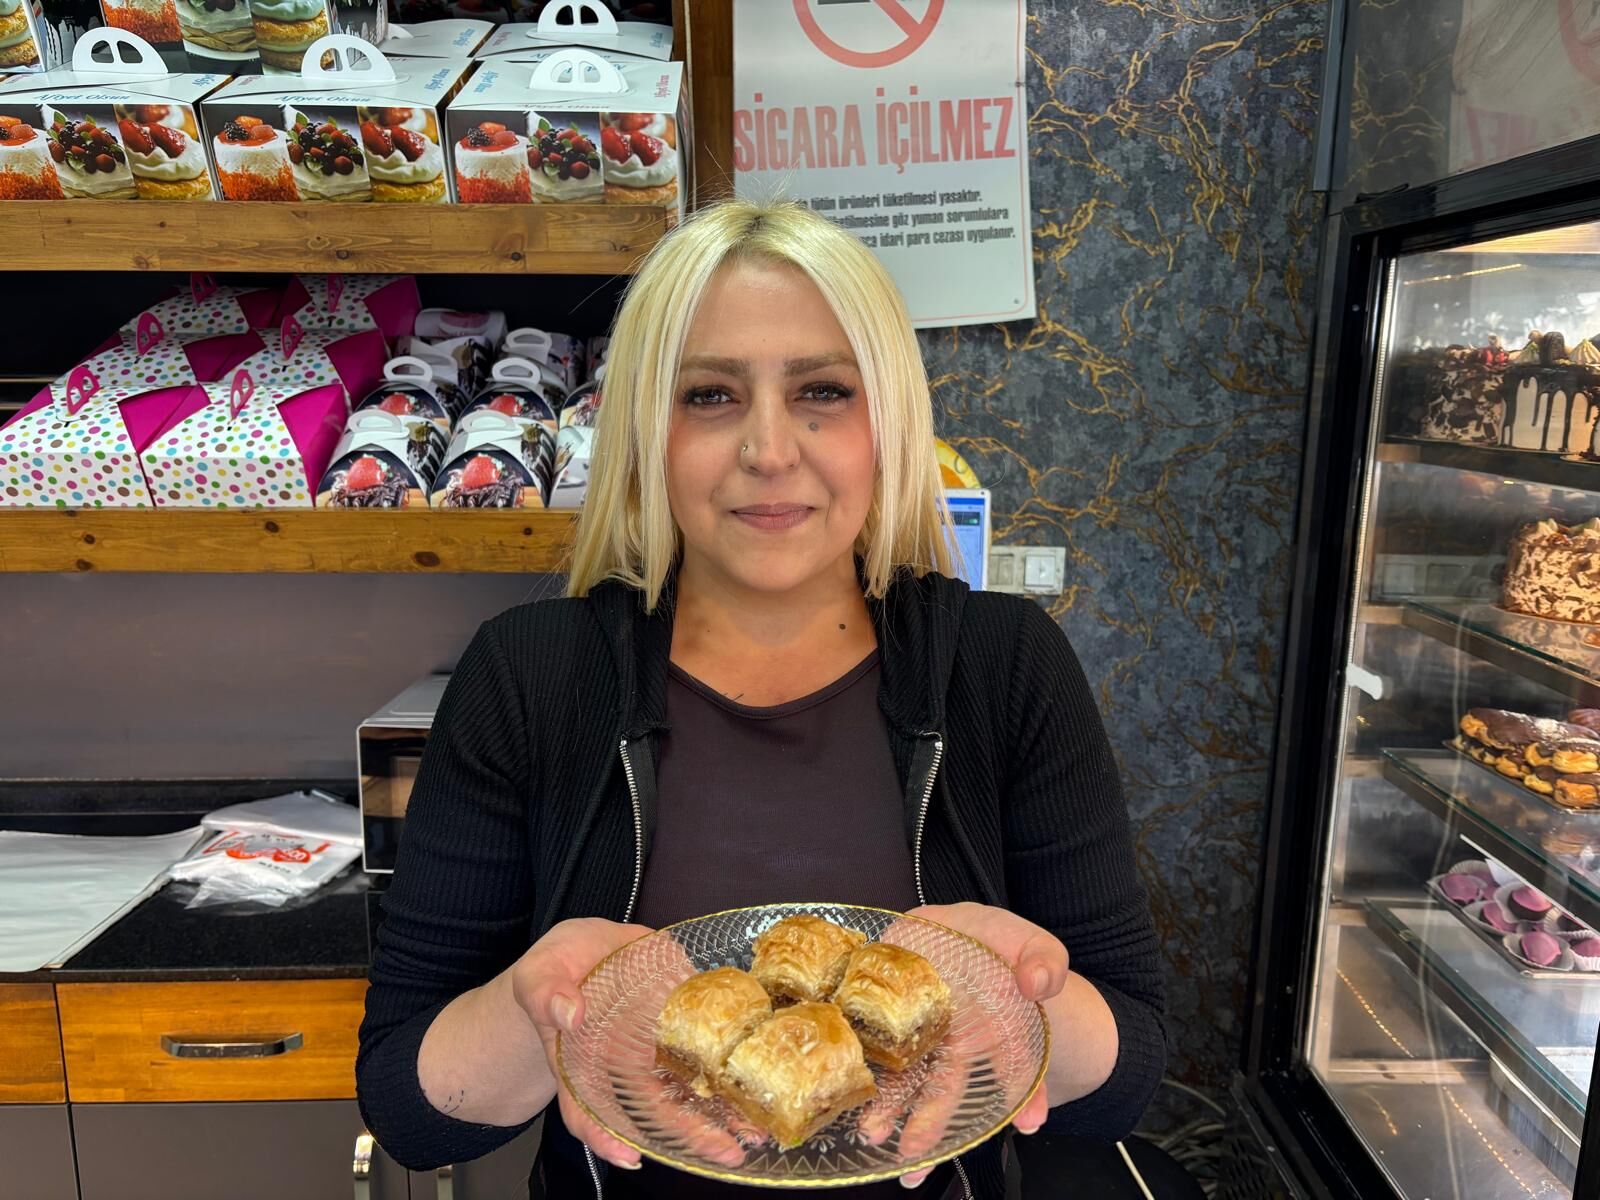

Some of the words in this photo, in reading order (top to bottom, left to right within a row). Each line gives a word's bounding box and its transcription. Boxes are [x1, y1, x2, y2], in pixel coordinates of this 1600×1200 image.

[733, 92, 867, 173] SİGARA
[875, 85, 1016, 175] İÇİLMEZ
[810, 195, 836, 211] tütün
[838, 193, 880, 210] ürünleri
[882, 190, 937, 208] tüketilmesi
[938, 188, 983, 207] yasaktır.
[891, 211, 910, 228] göz
[910, 211, 945, 228] yuman
[946, 206, 1009, 224] sorumlulara
[879, 231, 905, 248] idari
[905, 232, 931, 249] para
[932, 230, 965, 245] cezası
[966, 225, 1016, 245] uygulanır.
